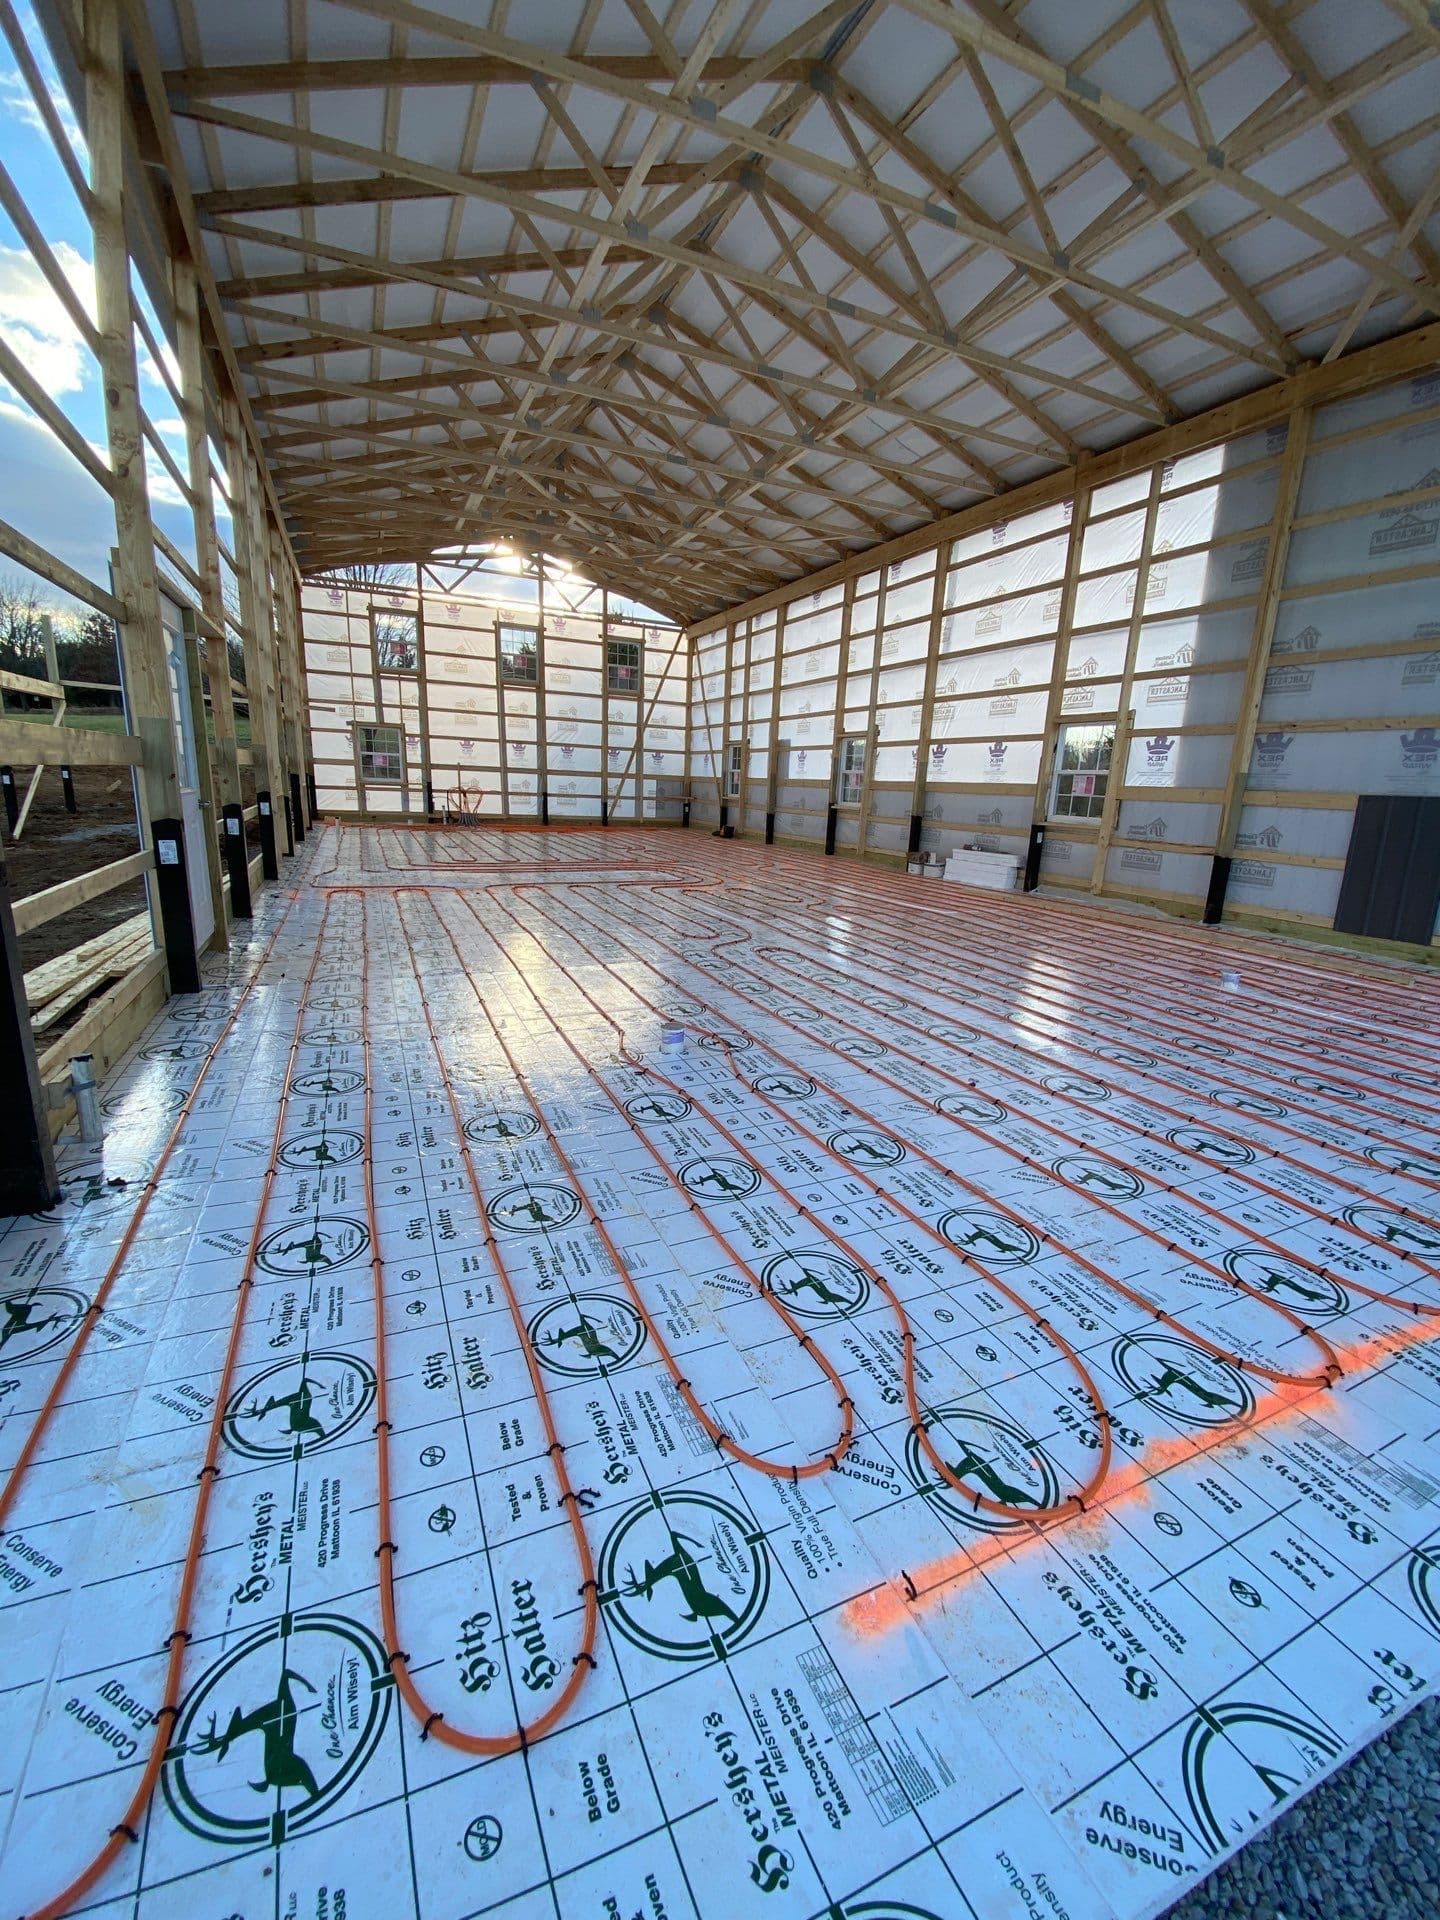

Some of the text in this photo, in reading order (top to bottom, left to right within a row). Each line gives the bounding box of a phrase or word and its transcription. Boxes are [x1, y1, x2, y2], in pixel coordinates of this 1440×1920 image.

[703, 1280, 753, 1298] Conserve
[152, 1393, 204, 1423] Conserve
[174, 1383, 214, 1408] Energy
[499, 1422, 512, 1451] Below
[511, 1418, 525, 1447] Grade
[616, 1419, 639, 1456] METAL
[842, 1451, 896, 1479] Energy
[297, 1490, 309, 1531] MEISTER
[505, 1484, 521, 1522] Tested
[534, 1474, 548, 1512] Proven
[1197, 1482, 1235, 1514] Below
[1206, 1477, 1243, 1510] Grade
[1311, 1475, 1361, 1513] METAL
[279, 1516, 295, 1565] METAL
[318, 1478, 329, 1568] 420 Progress Drive
[331, 1517, 341, 1560] Mattoon
[766, 1472, 826, 1564] 100% Virgin Produc
[787, 1481, 838, 1561] True Full Density
[6, 1534, 64, 1578] Conserve
[717, 1521, 750, 1574] Aim Wisely!
[791, 1539, 818, 1580] Quality
[1270, 1550, 1316, 1592] Tested
[1286, 1537, 1335, 1578] Proven
[1079, 1568, 1126, 1616] MEISTER
[1088, 1554, 1185, 1655] 420 Progress Drive
[1041, 1571, 1159, 1700] Hershey's
[1096, 1601, 1148, 1654] METAL
[1142, 1598, 1188, 1645] Mattoon
[96, 1680, 152, 1731] Energy
[346, 1657, 360, 1730] Aim Wisely!
[65, 1698, 138, 1760] Conserve
[325, 1731, 344, 1759] One
[753, 1706, 789, 1774] MEISTER
[784, 1688, 851, 1817] Mattoon IL 61938
[771, 1688, 842, 1830] 420 Progress Drive
[578, 1761, 602, 1823] Below
[597, 1753, 621, 1814] Grade
[703, 1711, 795, 1893] Hershey's
[754, 1750, 797, 1828] METAL
[1099, 1801, 1185, 1853] Energy
